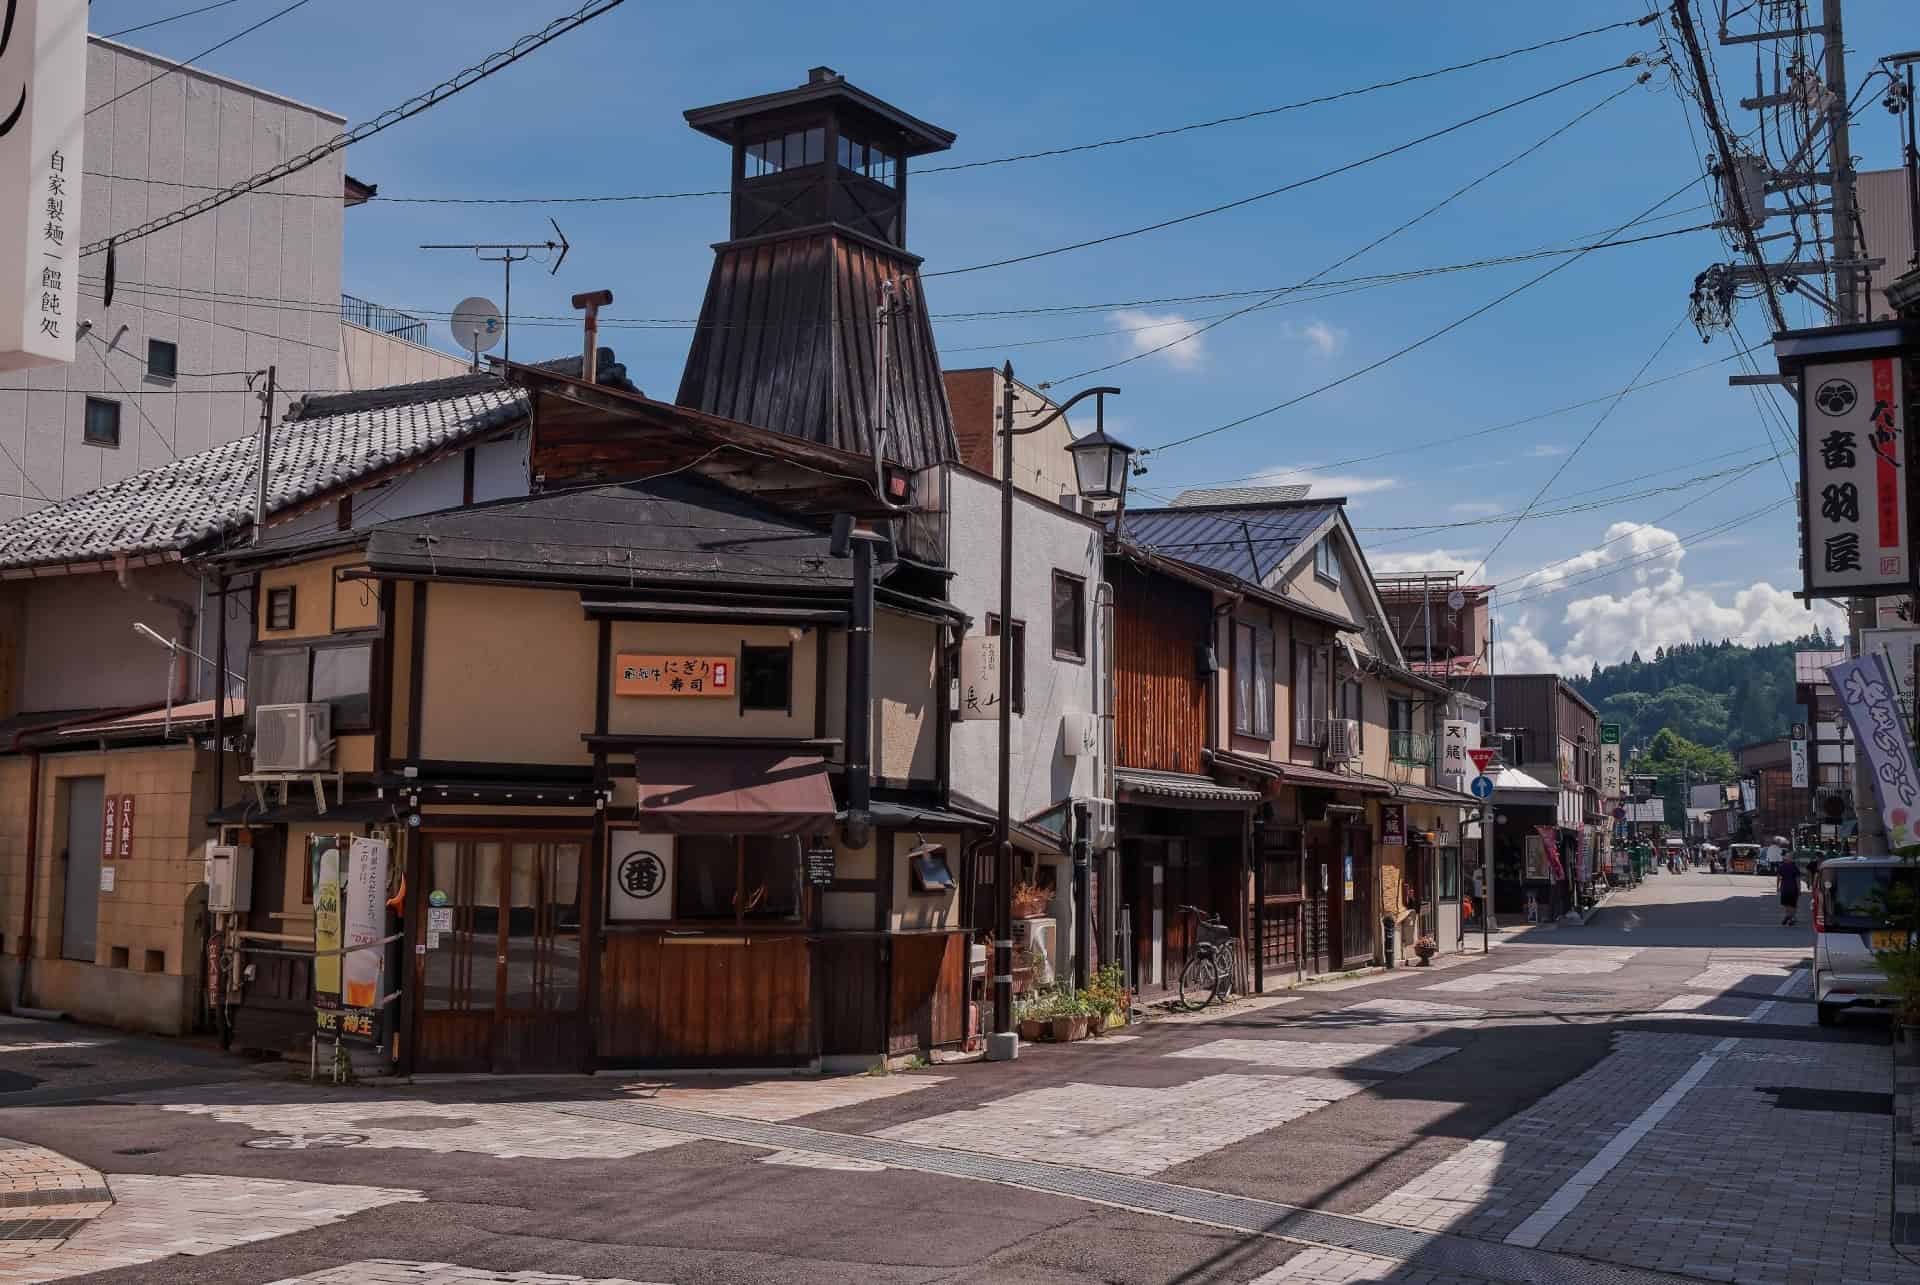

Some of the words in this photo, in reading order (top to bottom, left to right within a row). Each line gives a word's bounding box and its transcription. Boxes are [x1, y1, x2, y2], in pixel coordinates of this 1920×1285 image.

[1819, 430, 1862, 574] 音羽屋
[664, 660, 710, 676] にぎり
[670, 678, 703, 692] 寿司
[625, 857, 659, 892] 番
